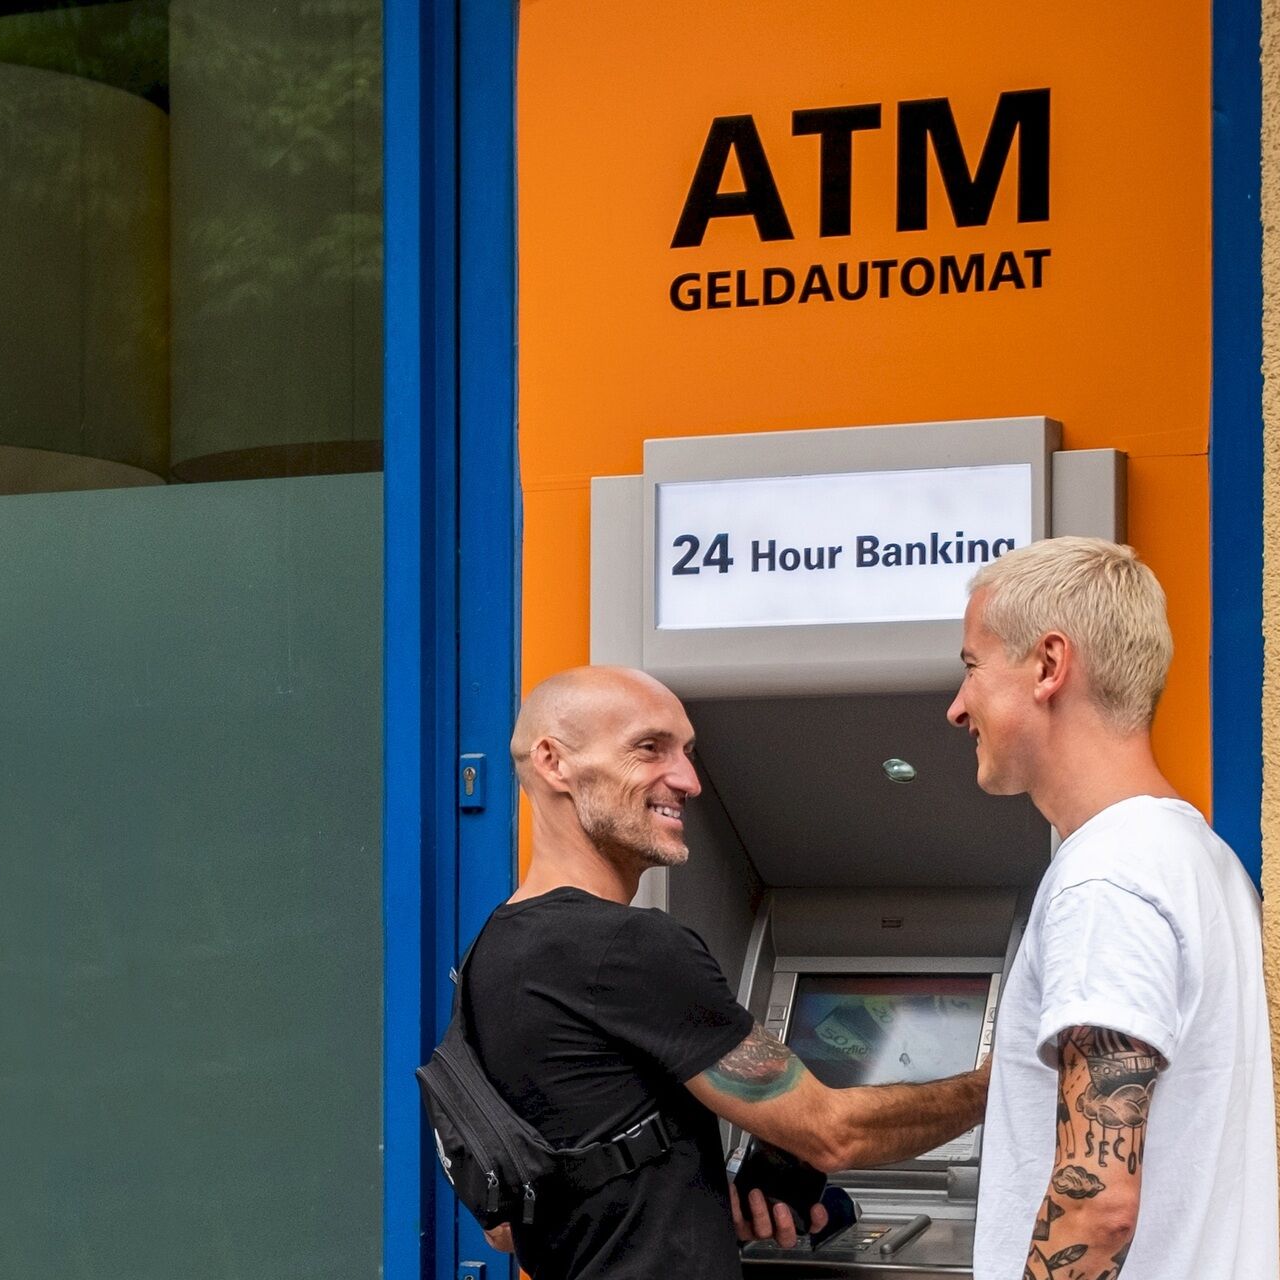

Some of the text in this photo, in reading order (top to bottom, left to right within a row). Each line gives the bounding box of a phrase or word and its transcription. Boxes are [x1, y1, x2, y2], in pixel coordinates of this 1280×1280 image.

[670, 87, 1051, 249] ATM
[669, 248, 1051, 312] GELDAUTOMAT
[672, 533, 734, 575] 24
[751, 539, 843, 572] Hour
